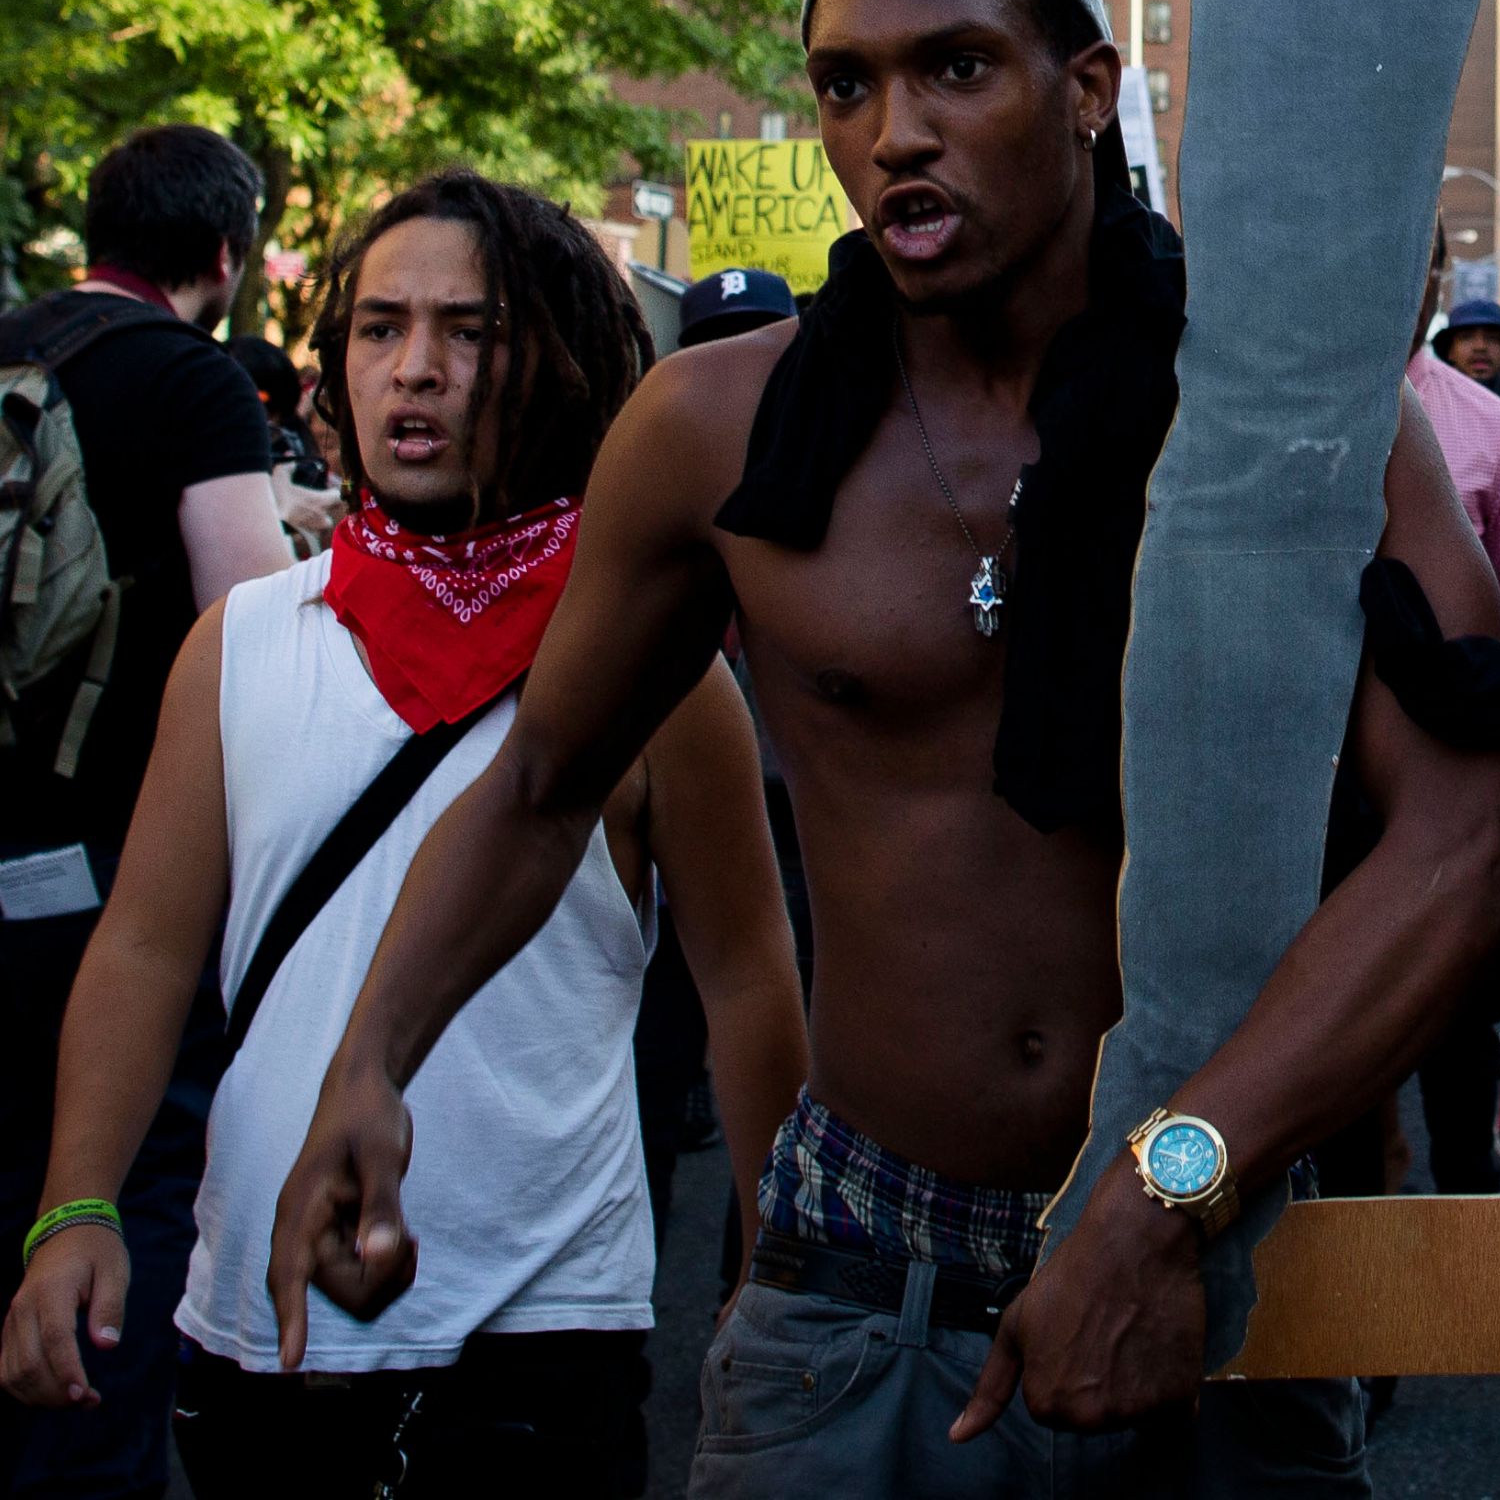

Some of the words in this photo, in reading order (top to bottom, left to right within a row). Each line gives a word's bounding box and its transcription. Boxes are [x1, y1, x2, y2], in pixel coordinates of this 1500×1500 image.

[688, 144, 779, 191] WAKE
[790, 144, 832, 192] UP
[688, 189, 844, 238] AMERICA
